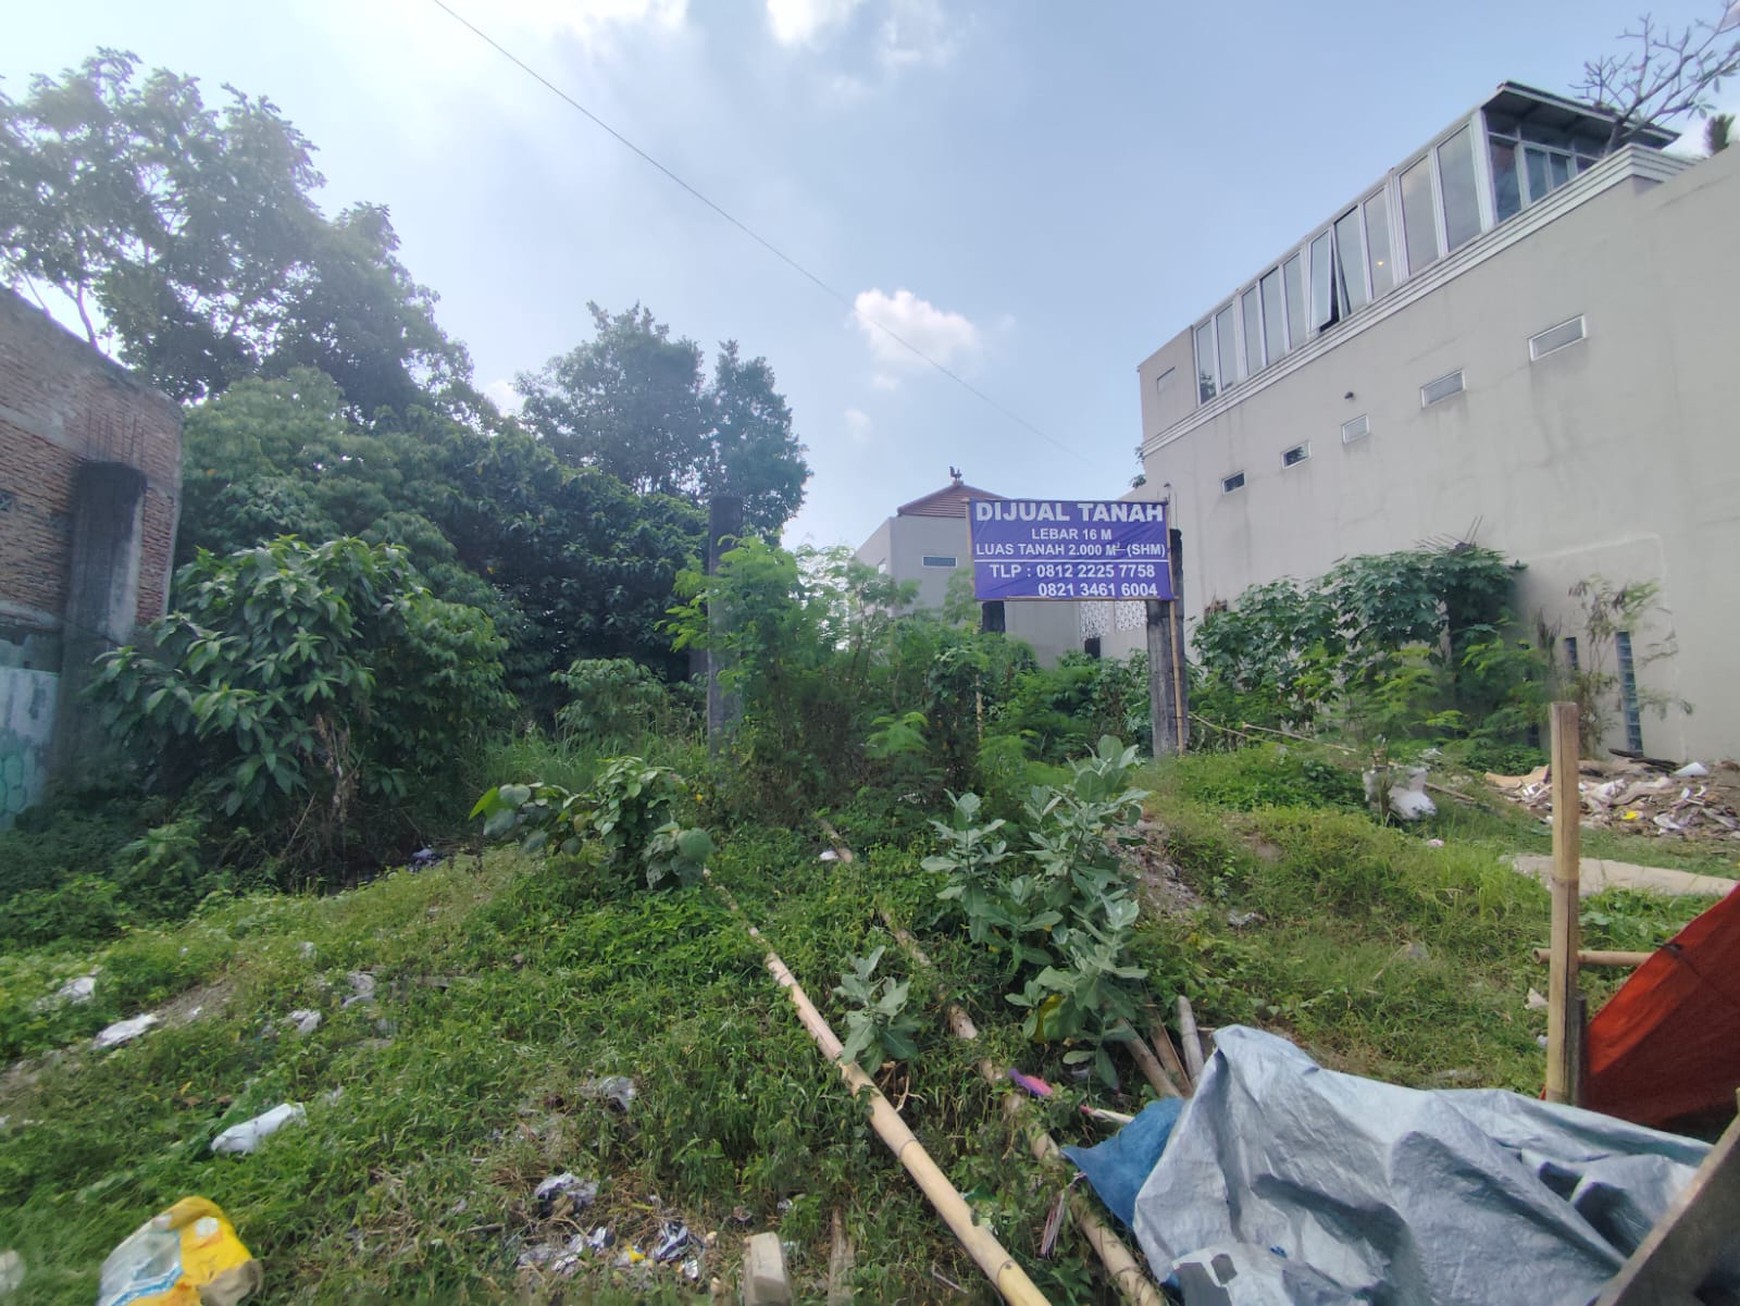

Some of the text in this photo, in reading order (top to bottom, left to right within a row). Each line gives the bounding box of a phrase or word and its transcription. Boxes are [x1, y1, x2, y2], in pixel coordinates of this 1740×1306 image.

[976, 503, 1163, 522] DIJUAL TANAH
[1032, 528, 1112, 540] LEBAR 16 M
[976, 544, 1014, 555] LUAS
[1018, 544, 1064, 555] TANAH
[1069, 545, 1102, 555] 2.000
[1127, 544, 1165, 557] (SHM)
[990, 565, 1021, 577] TLP
[1037, 565, 1073, 577] 0812
[1078, 565, 1114, 577] 2225
[1120, 565, 1155, 577] 7758
[1038, 583, 1157, 596] 0821 3461 6004
